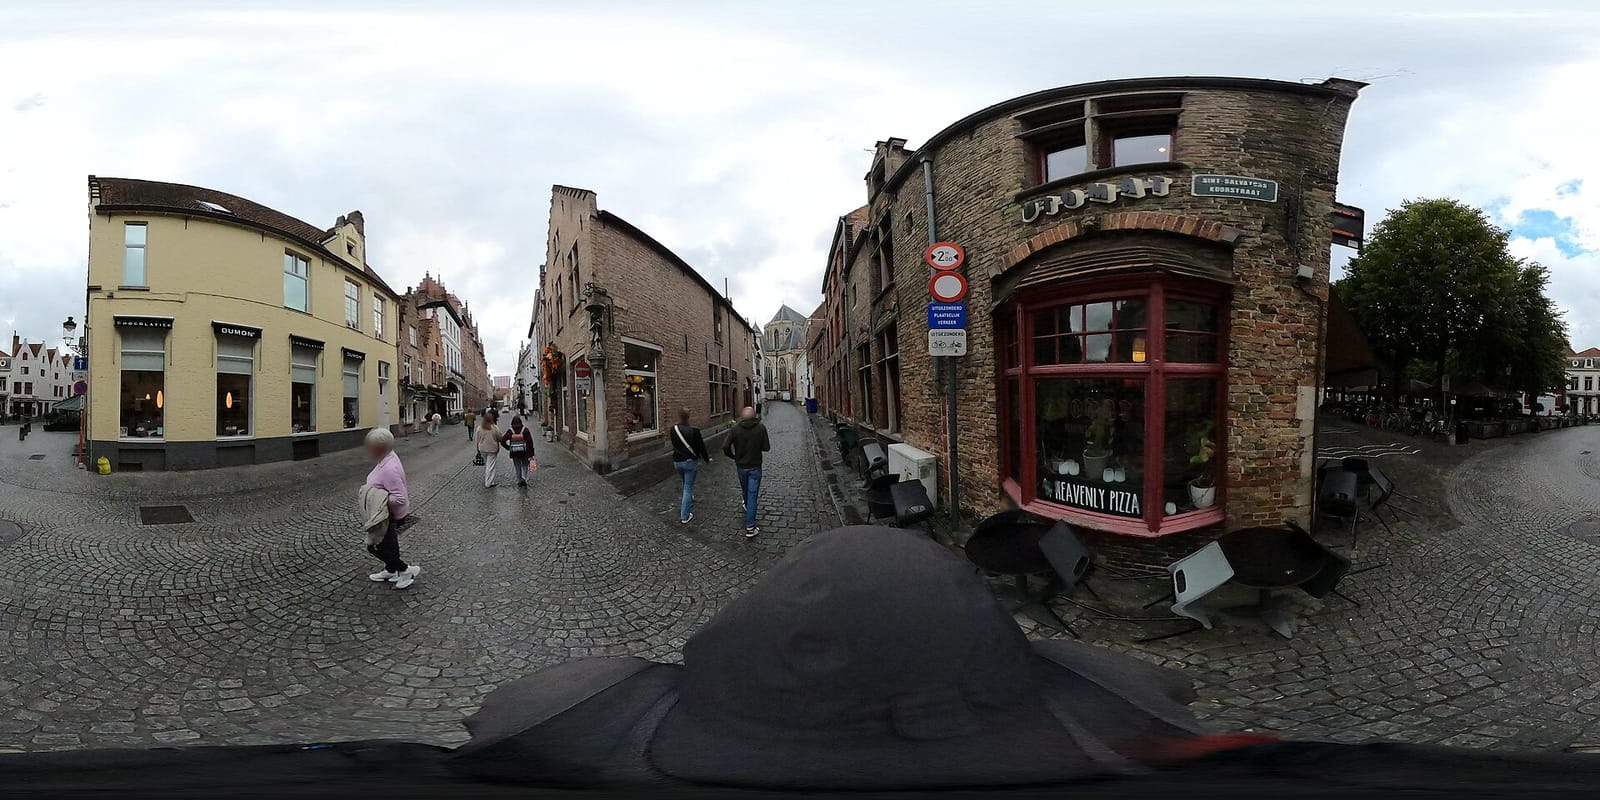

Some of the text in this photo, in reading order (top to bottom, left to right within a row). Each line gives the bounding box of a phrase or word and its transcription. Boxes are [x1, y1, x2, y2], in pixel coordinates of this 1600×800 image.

[1209, 186, 1261, 196] KOORSTRAAT
[937, 250, 945, 262] 2
[1054, 480, 1141, 515] HEAVENLY PIZZA
